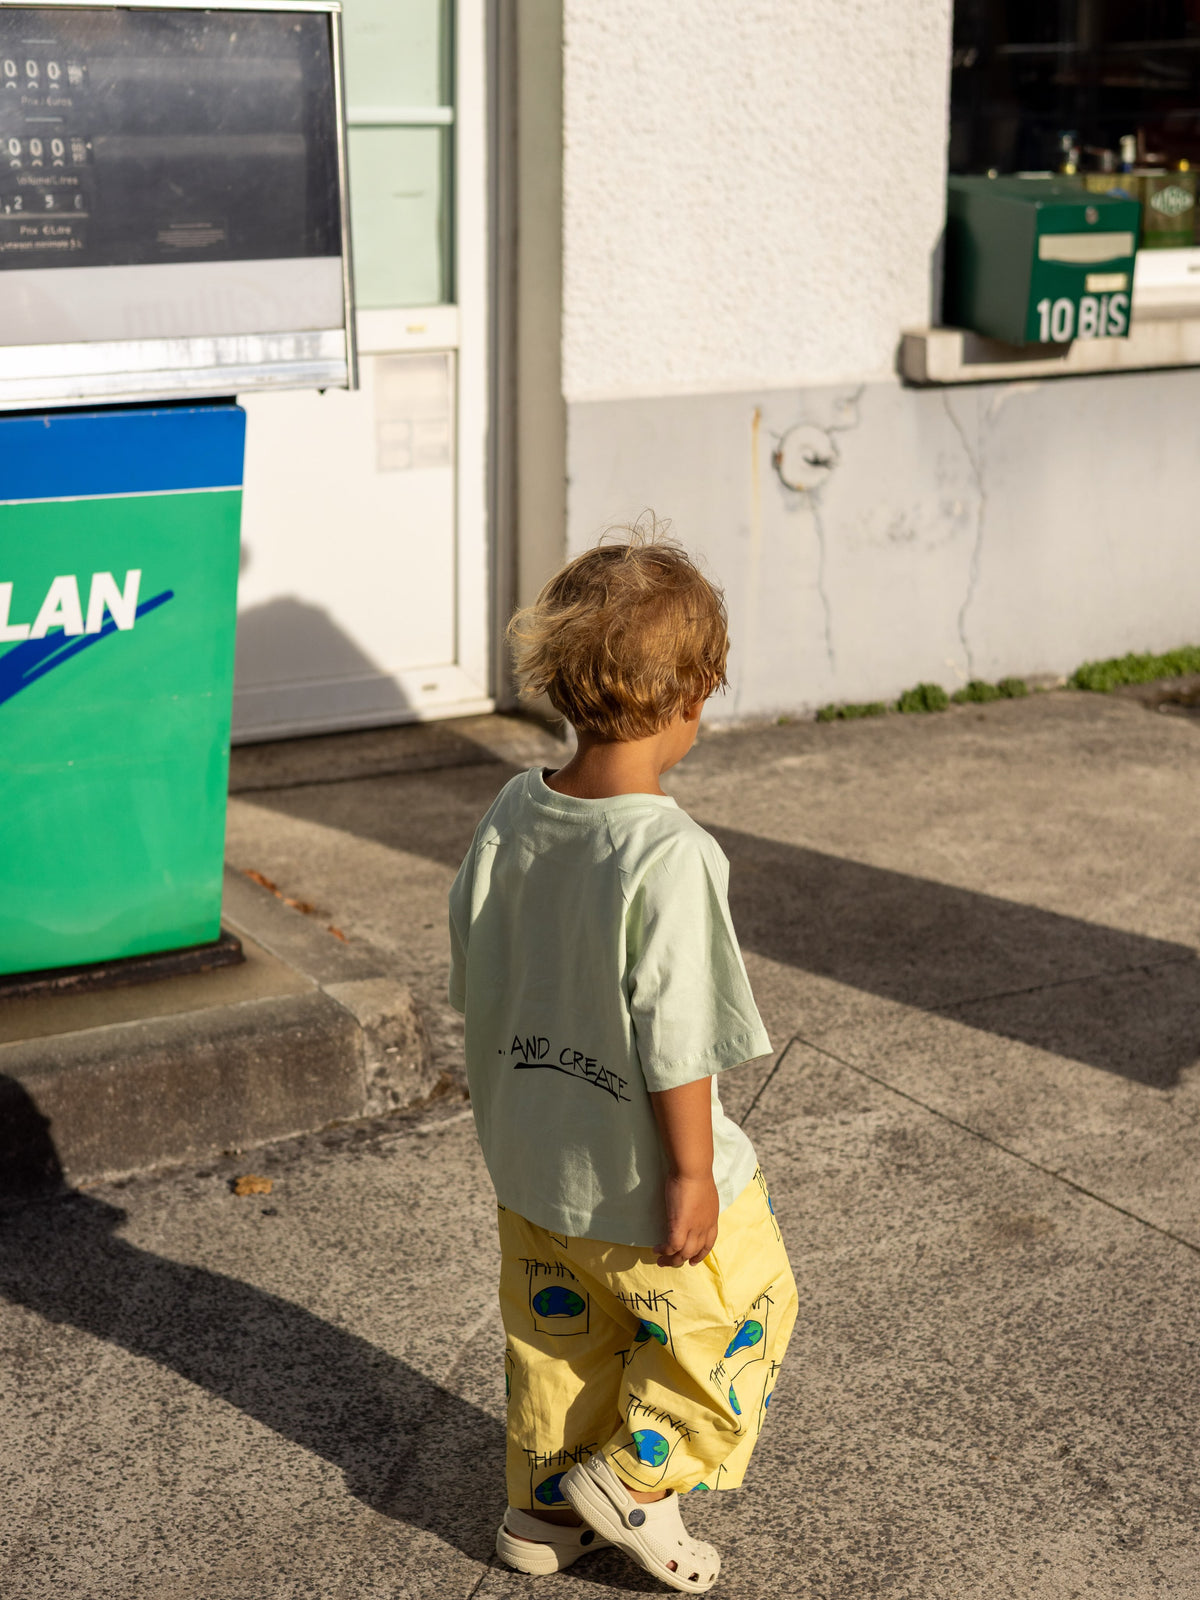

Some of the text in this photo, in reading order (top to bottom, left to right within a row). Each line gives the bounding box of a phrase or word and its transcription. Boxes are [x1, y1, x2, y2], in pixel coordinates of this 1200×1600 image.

[1037, 293, 1128, 343] 10 BIS
[559, 1048, 632, 1102] CREATE
